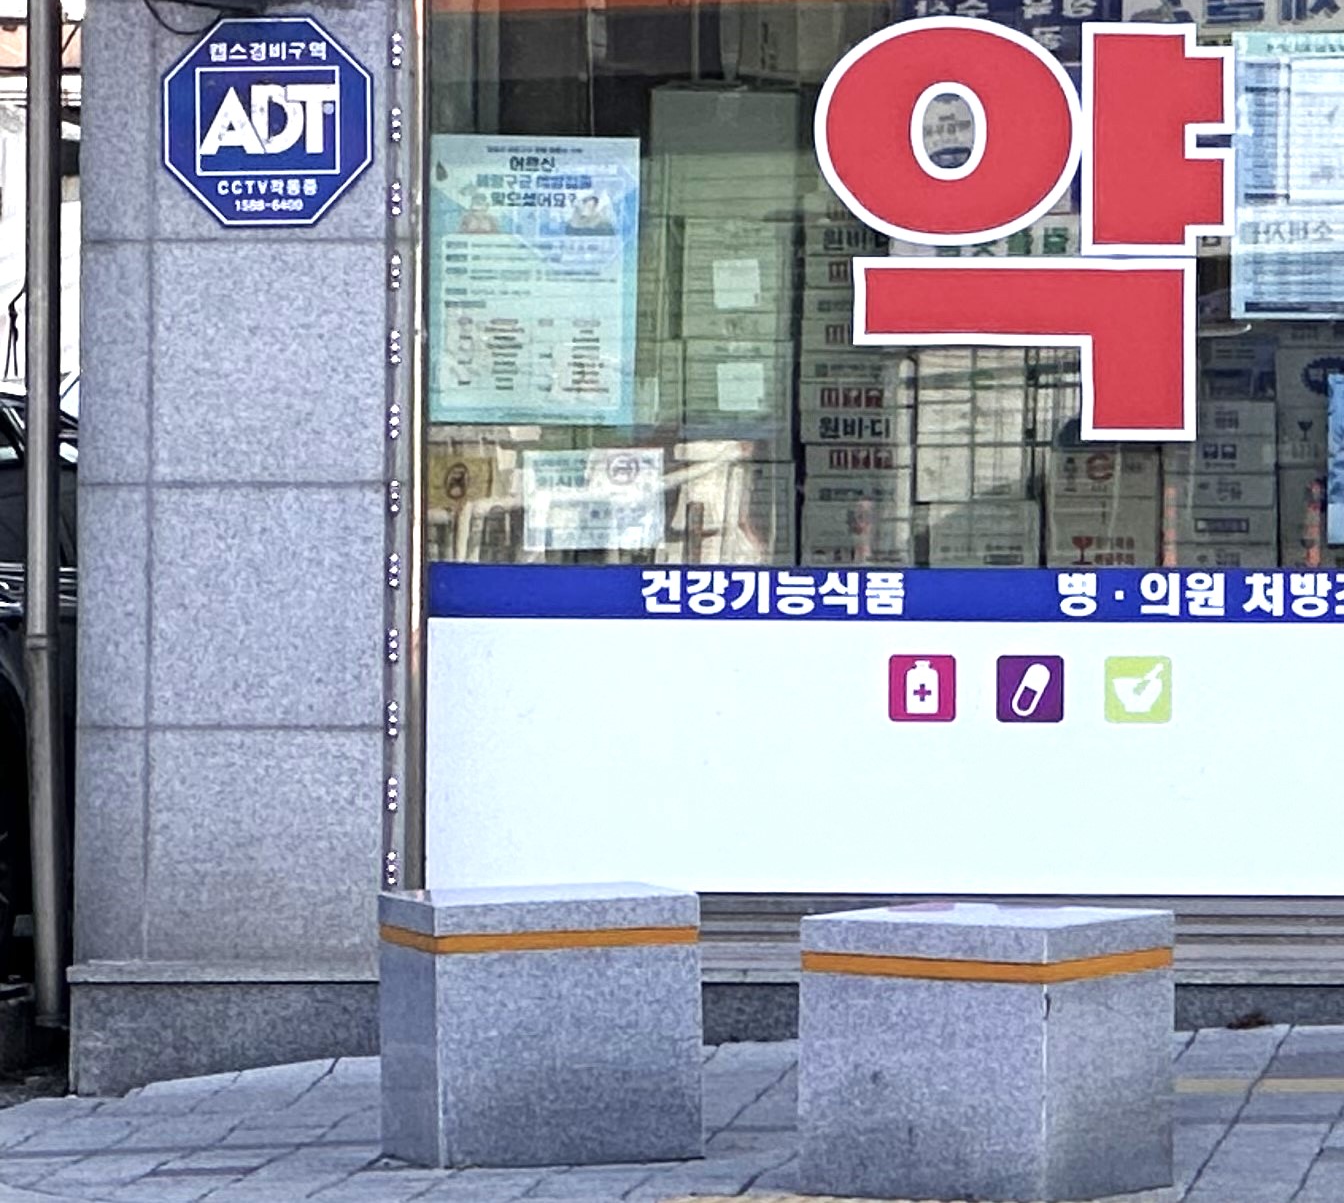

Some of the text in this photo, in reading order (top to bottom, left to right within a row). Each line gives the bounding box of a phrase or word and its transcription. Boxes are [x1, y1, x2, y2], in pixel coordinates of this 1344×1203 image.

[210, 41, 327, 62] 캡스경비구역
[200, 84, 340, 155] ADT
[217, 178, 318, 196] CCTV작동중
[814, 16, 1236, 442] 약
[641, 571, 905, 616] 건강기능식품
